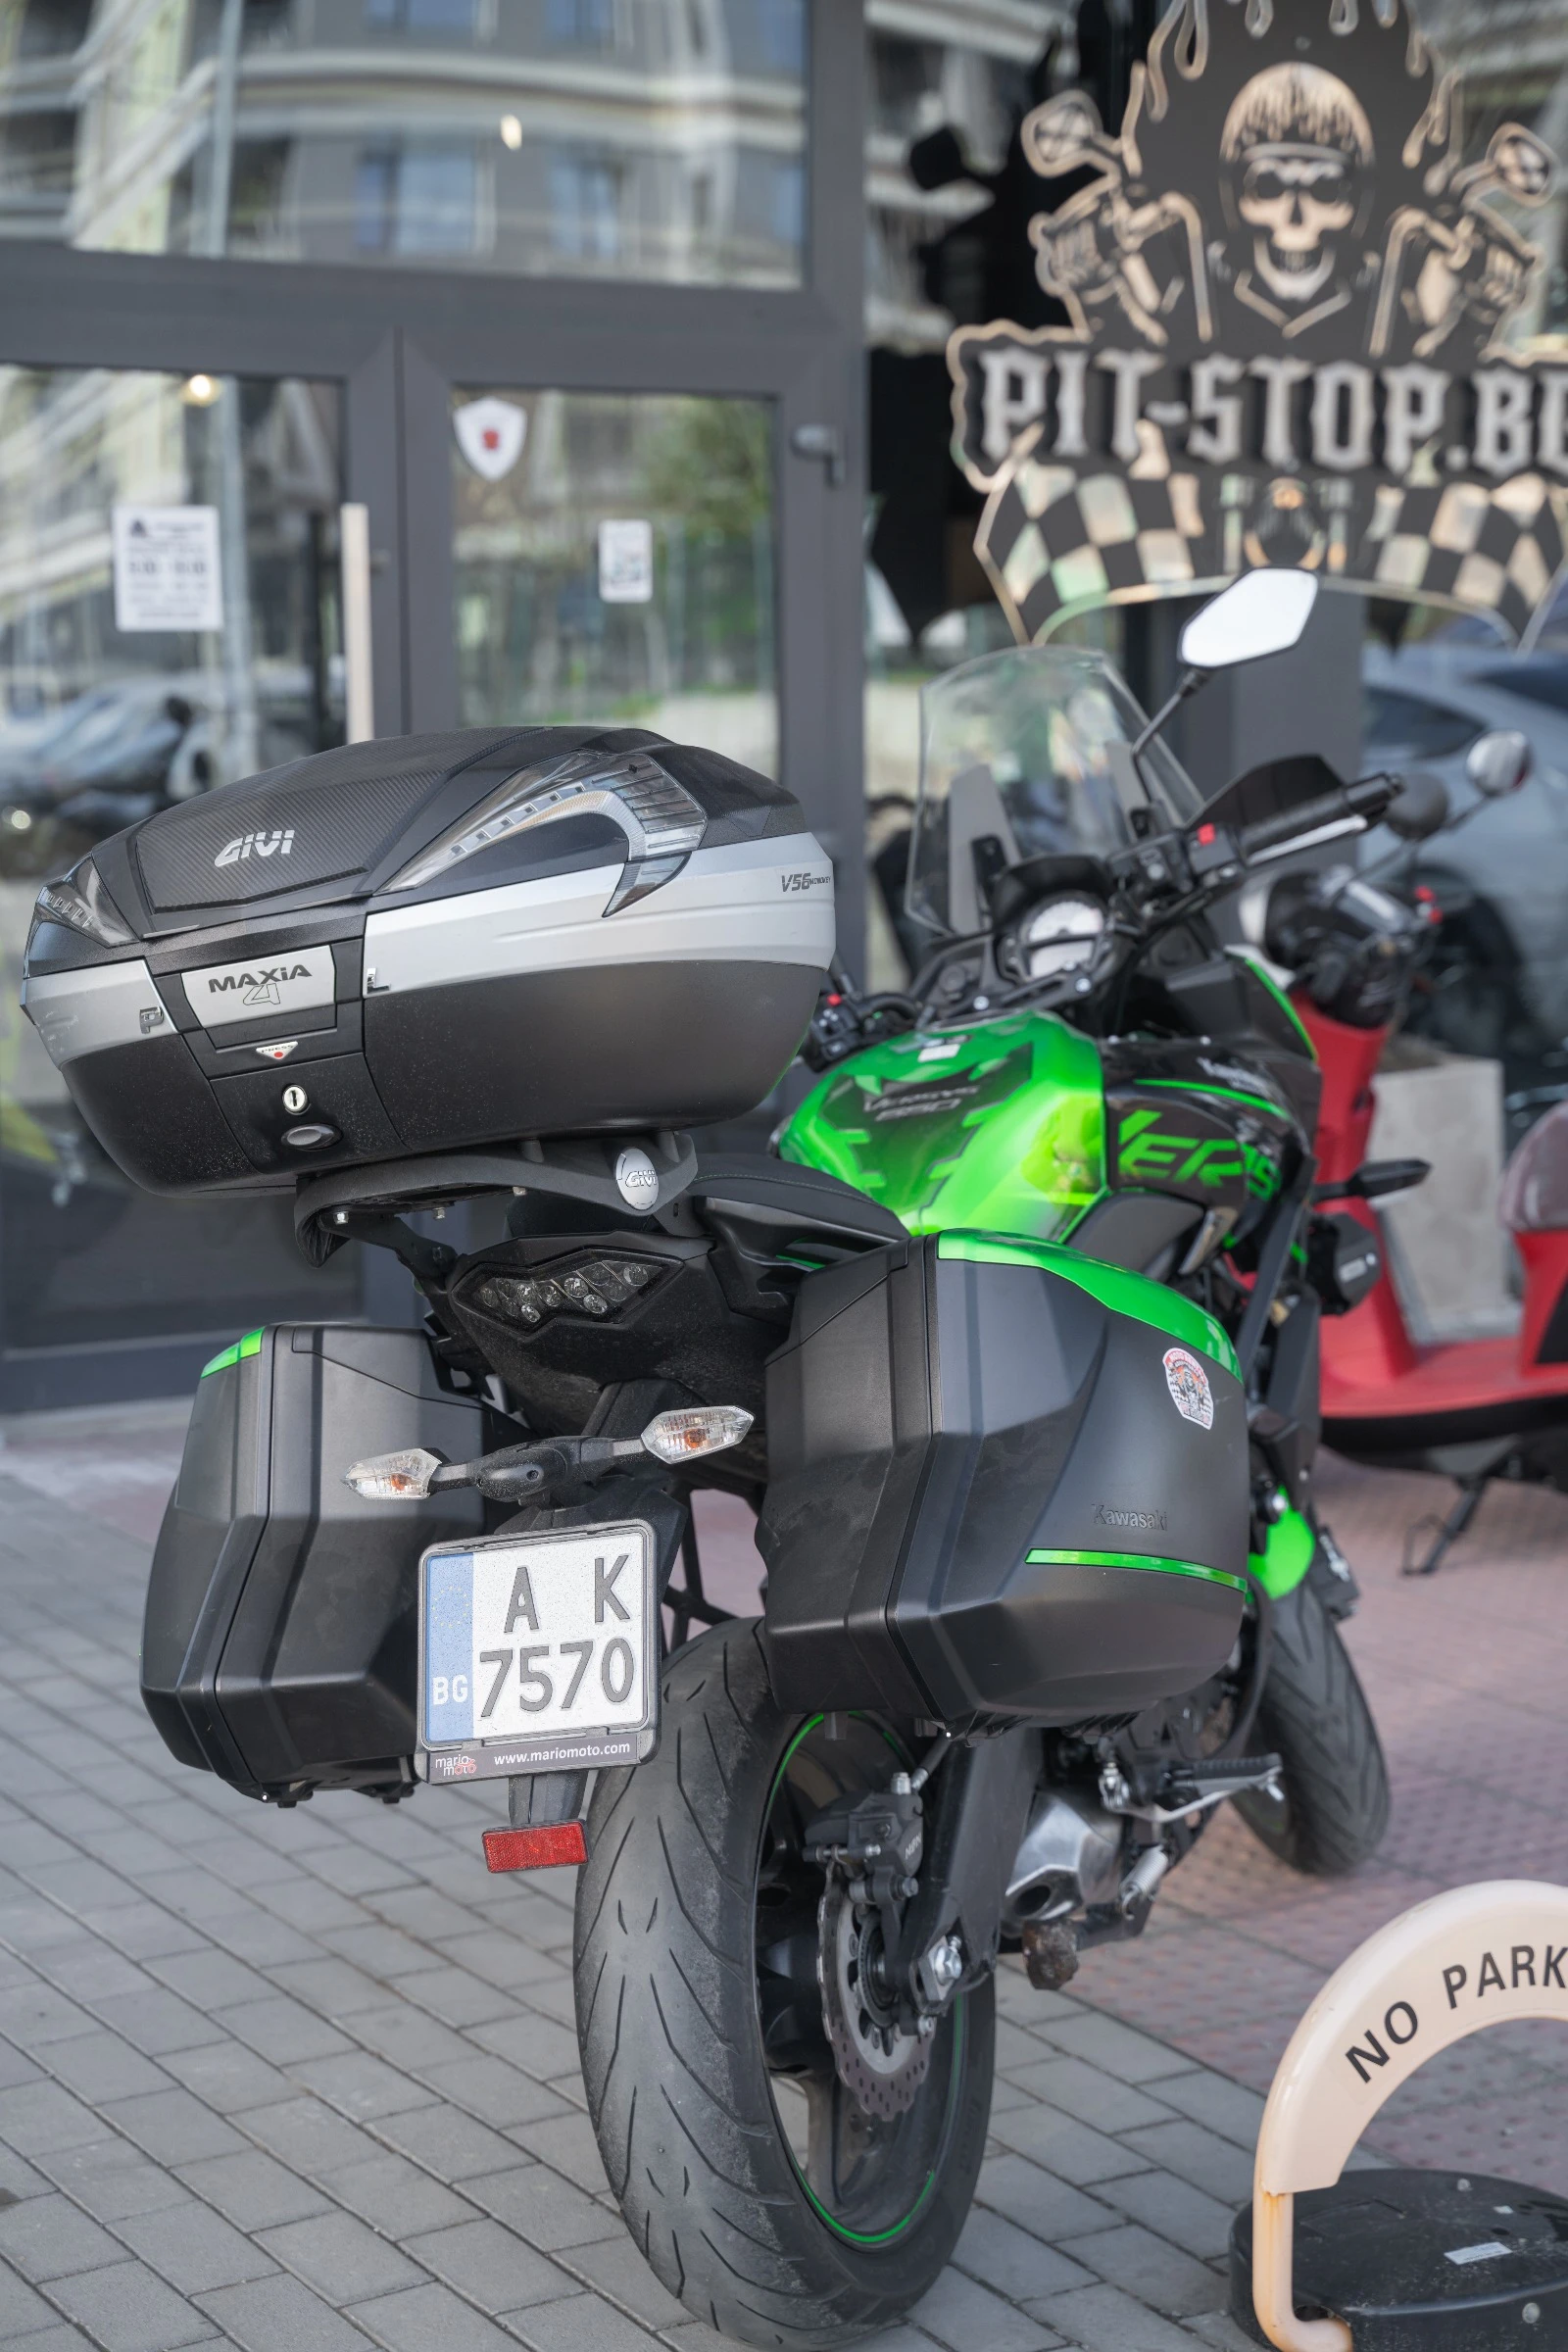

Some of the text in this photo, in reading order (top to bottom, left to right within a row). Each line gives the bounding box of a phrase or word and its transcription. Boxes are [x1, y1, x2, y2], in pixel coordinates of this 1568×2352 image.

[214, 829, 295, 867] GIVI
[781, 872, 811, 893] V56
[625, 1170, 657, 1188] GIVI
[1091, 1503, 1168, 1532] Kawasaki
[504, 1553, 631, 1634] A K
[432, 1674, 468, 1705] BG
[479, 1637, 635, 1718] 7570
[435, 1754, 470, 1768] mario
[494, 1741, 630, 1765] www.mariomoto.com
[1345, 2000, 1418, 2083] NO
